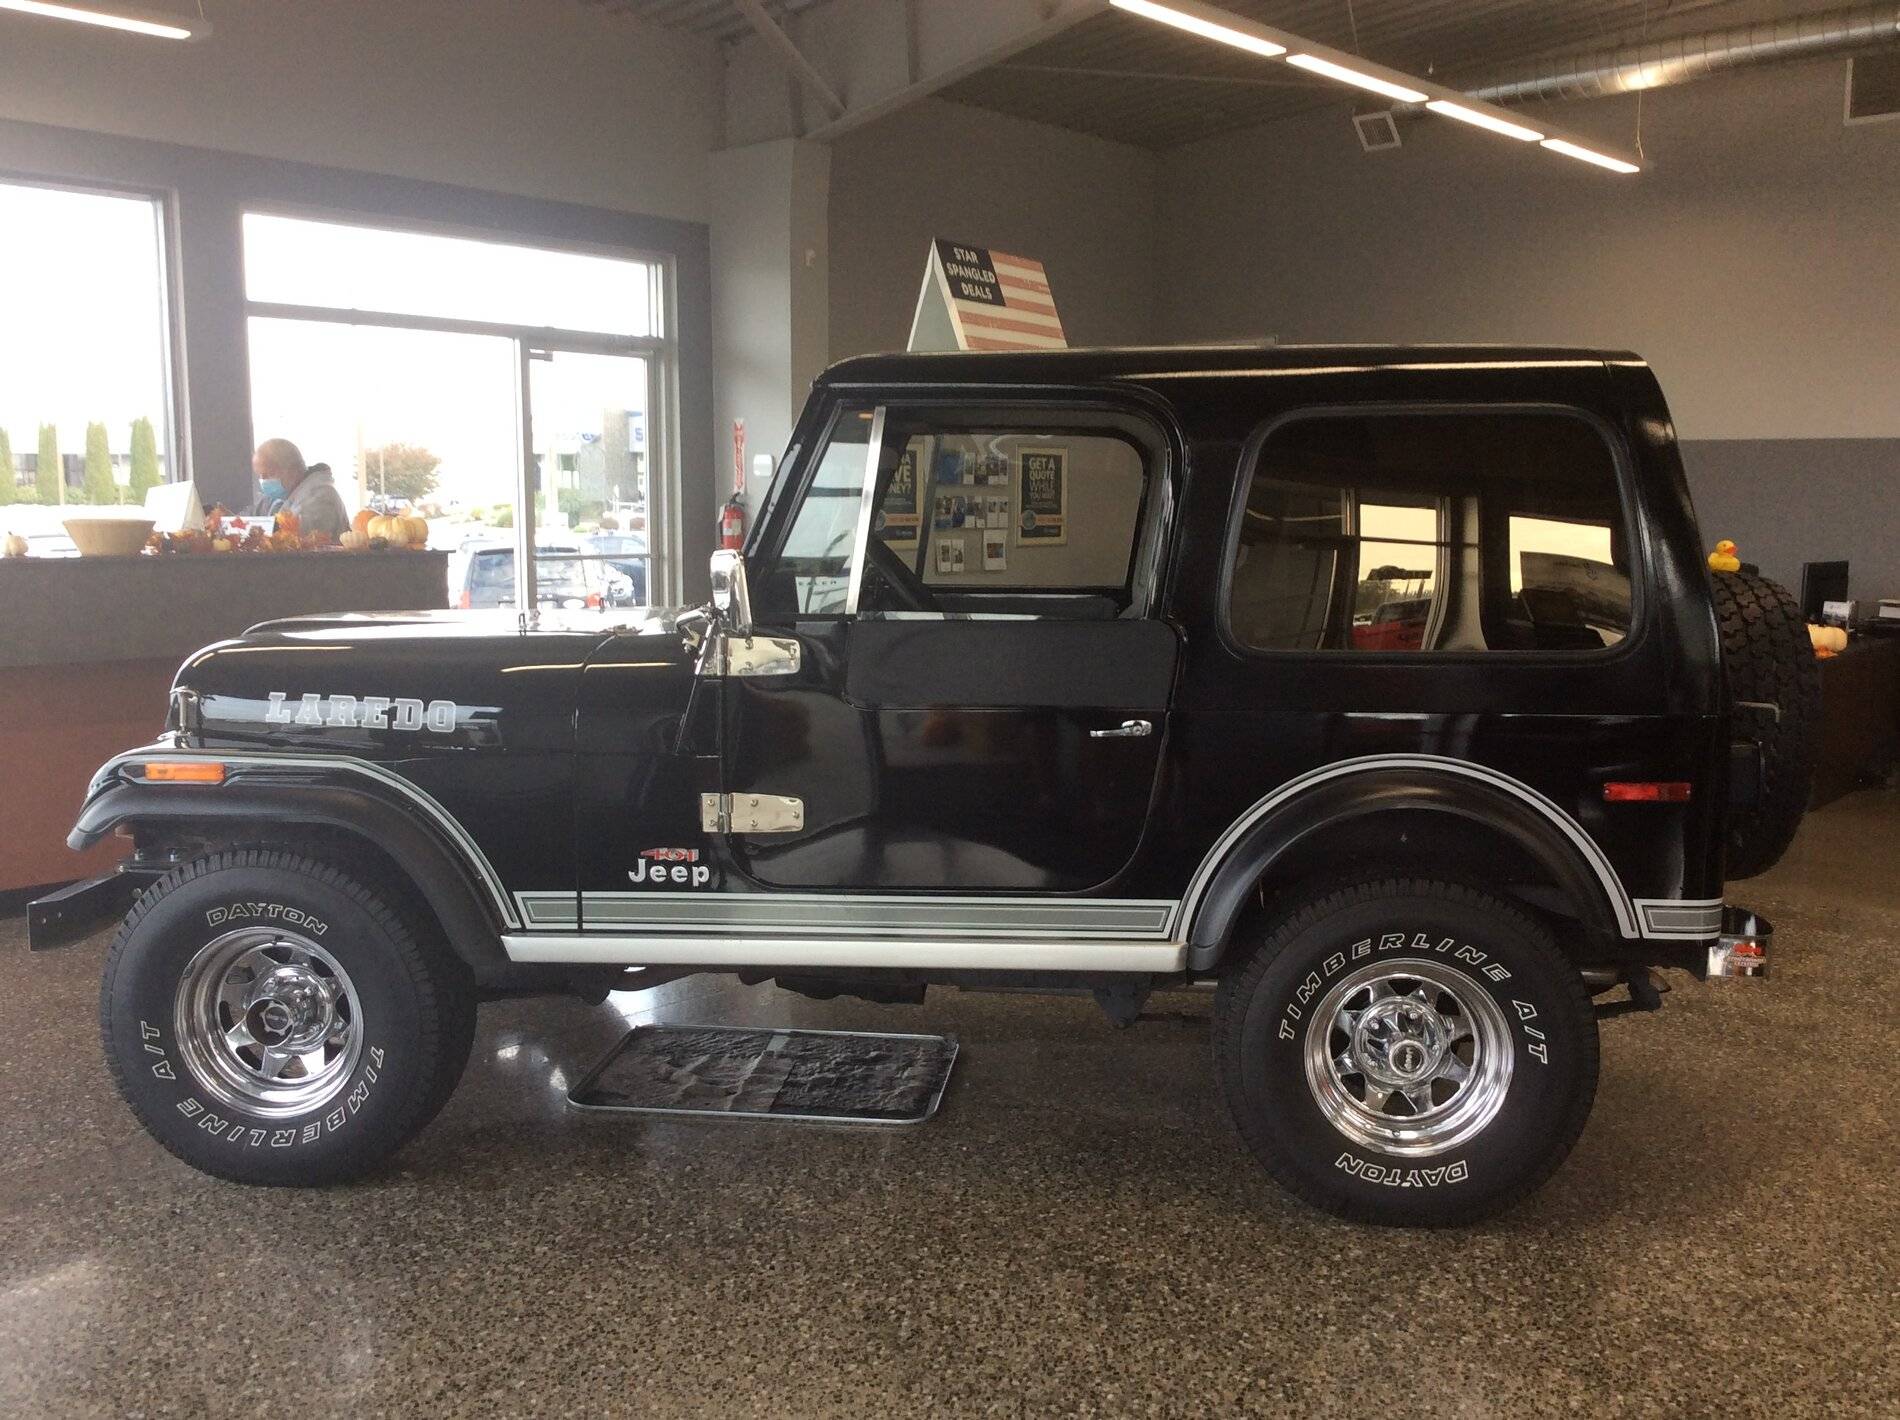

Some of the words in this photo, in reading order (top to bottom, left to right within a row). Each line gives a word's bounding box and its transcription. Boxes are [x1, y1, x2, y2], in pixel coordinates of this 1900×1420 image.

[953, 246, 979, 263] STAR
[946, 262, 996, 284] SPANGLED
[960, 282, 993, 301] DEALS
[1028, 457, 1047, 470] GET
[1048, 457, 1056, 471] A
[1028, 470, 1056, 481] QUOTE
[264, 691, 457, 733] LAREDO
[628, 858, 710, 887] Jeep
[206, 902, 329, 936] DAYTON
[1278, 931, 1513, 1041] TIMBERLINE
[1511, 998, 1549, 1066] A/T
[140, 1020, 177, 1081] A/T
[176, 1046, 386, 1149] TIMBERLINE
[1335, 1151, 1470, 1188] DAYTON
